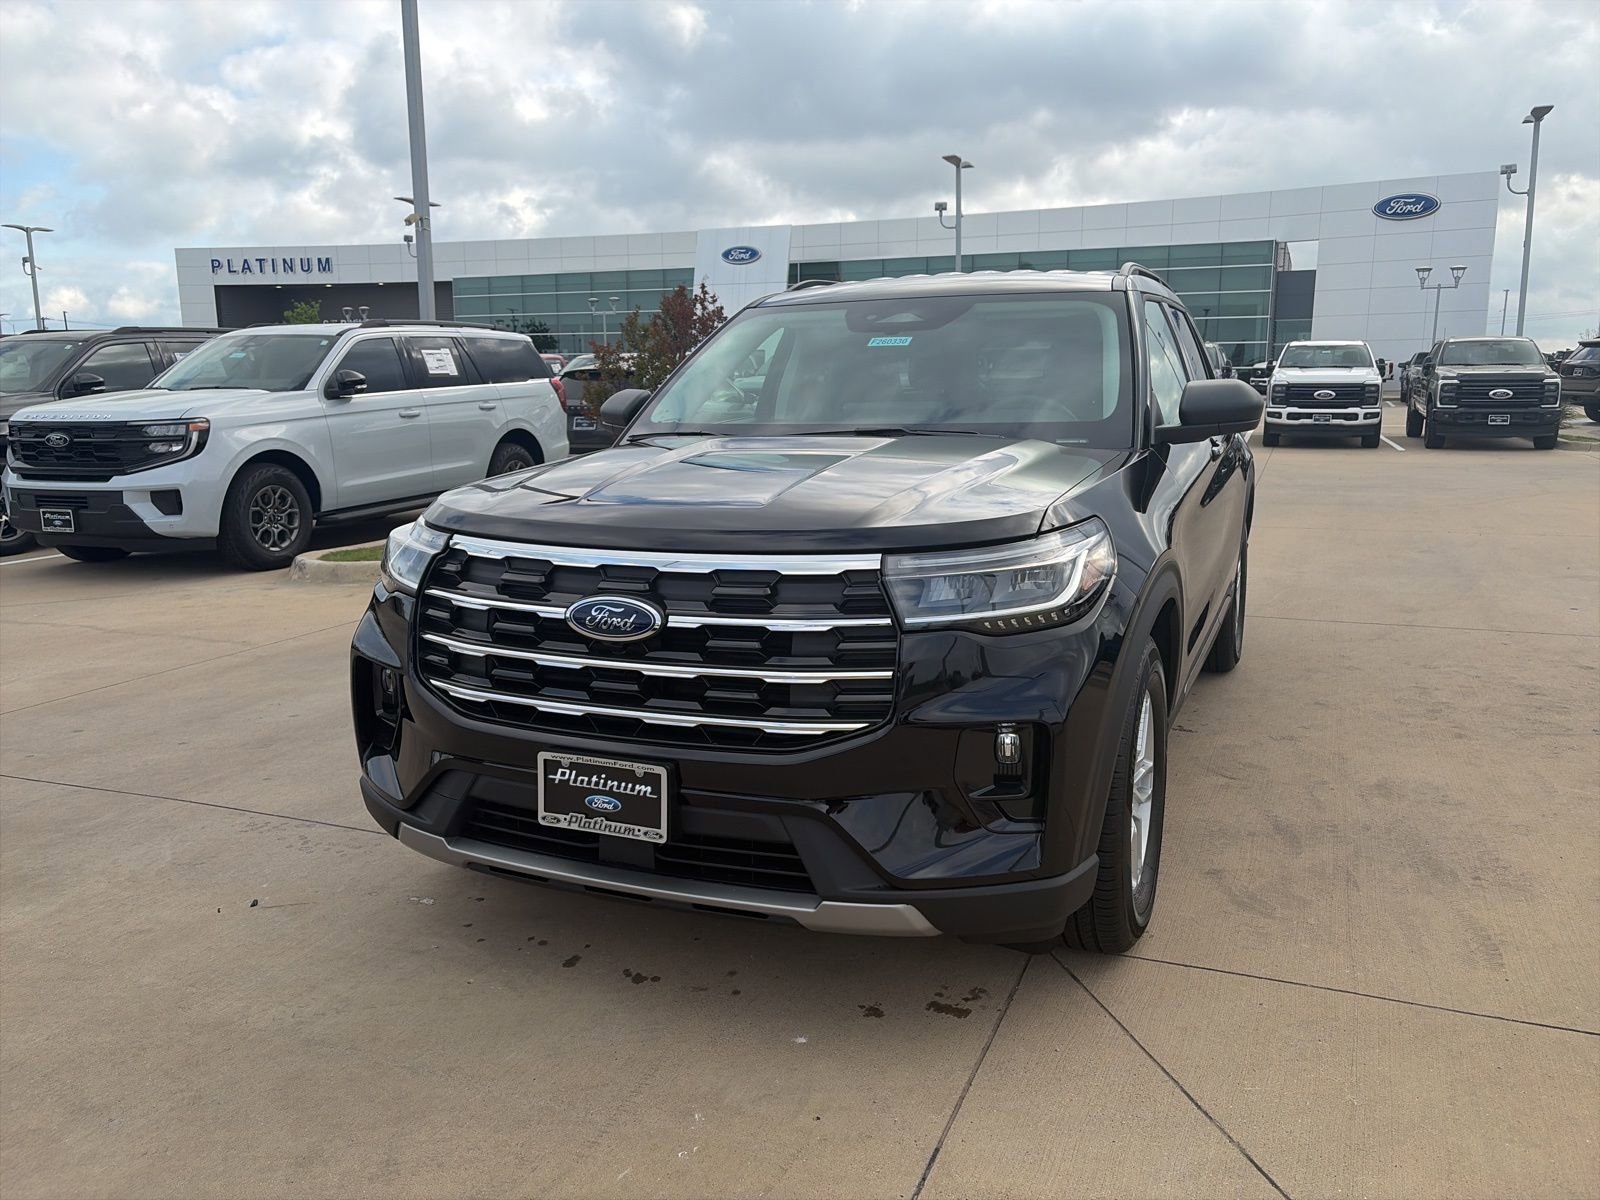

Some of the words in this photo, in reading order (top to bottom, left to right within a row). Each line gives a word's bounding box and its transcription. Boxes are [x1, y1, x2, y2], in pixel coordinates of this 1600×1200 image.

[1386, 198, 1425, 214] Ford
[729, 249, 752, 260] Ford
[211, 257, 333, 274] PLATINUM
[585, 605, 637, 631] Ford
[551, 754, 655, 772] www.PlatinumFord.com
[547, 768, 658, 798] Platinum
[592, 797, 615, 810] Ford
[567, 814, 641, 837] Platinum
